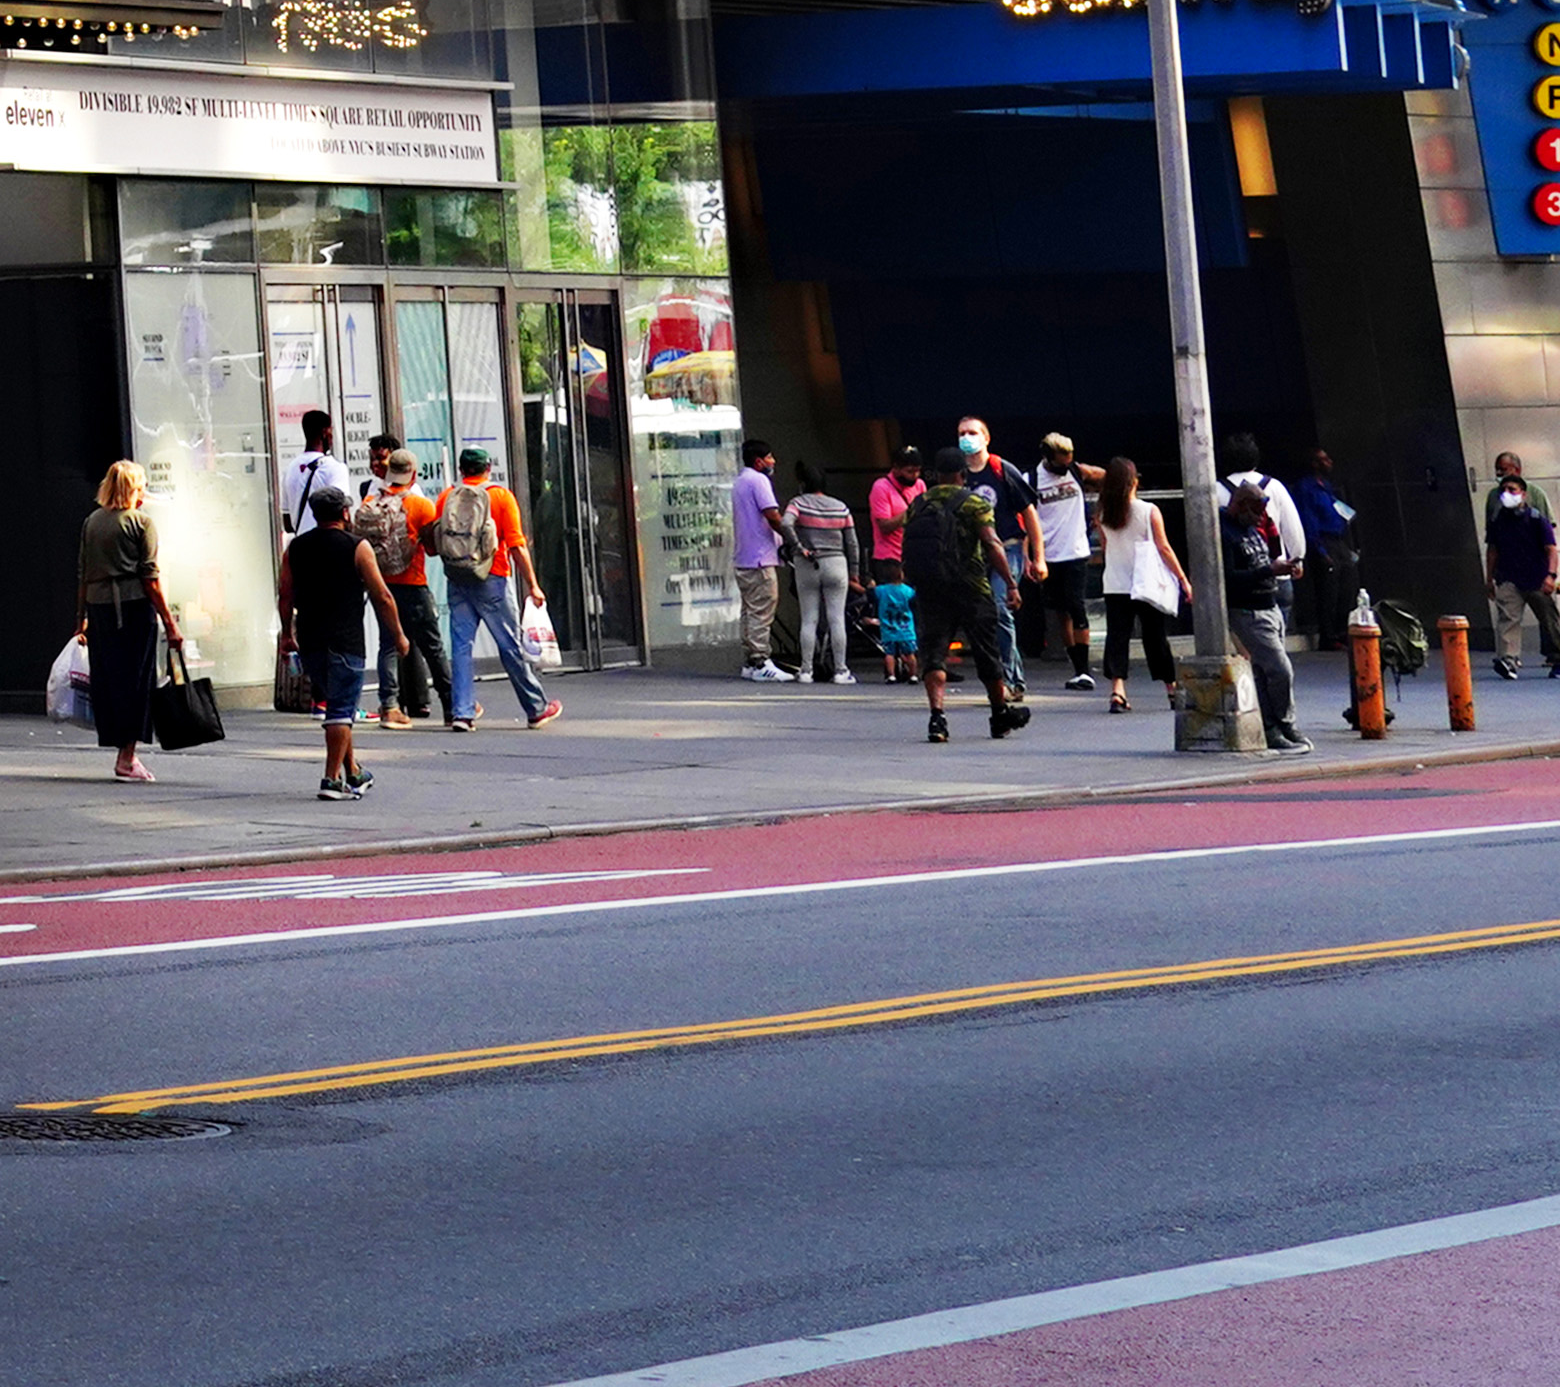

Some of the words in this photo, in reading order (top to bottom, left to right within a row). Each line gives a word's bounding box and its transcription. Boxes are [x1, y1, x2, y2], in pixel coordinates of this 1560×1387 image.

[6, 99, 54, 127] eleven
[79, 90, 143, 114] DIVISIBLE
[184, 98, 200, 117] SF
[202, 98, 277, 122] MULTI-LEVEL
[282, 103, 317, 124] TIMES
[319, 105, 364, 129] SQUARE
[366, 108, 407, 128] RETAIL
[408, 110, 483, 133] OPPORTUNITY
[317, 138, 346, 155] ABOVE
[348, 139, 374, 157] NYC'S
[376, 141, 412, 158] BUSIEST
[449, 145, 486, 161] STATION
